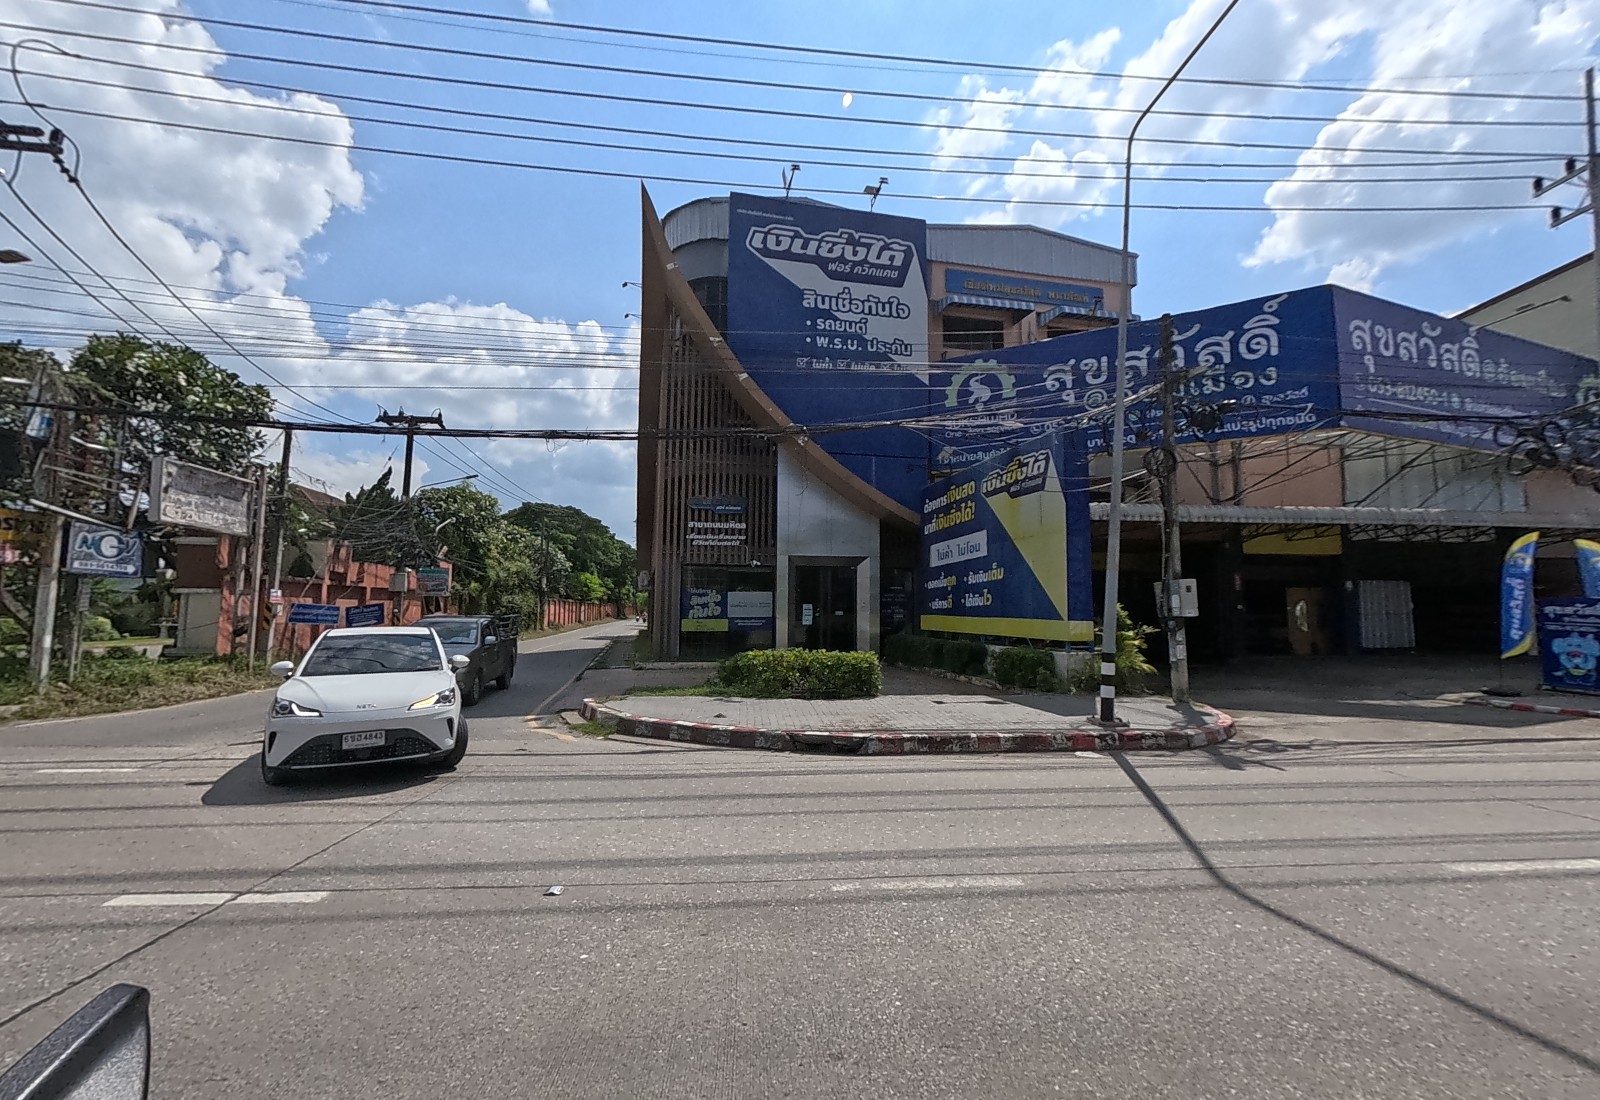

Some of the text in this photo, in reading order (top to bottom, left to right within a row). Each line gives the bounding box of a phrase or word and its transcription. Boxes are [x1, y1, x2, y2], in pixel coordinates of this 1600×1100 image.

[828, 261, 899, 278] ฟอร์ ควิกแคช
[802, 288, 911, 319] สินเชื่อทันใจ
[816, 318, 867, 334] รถยนต์
[816, 335, 913, 356] พ.ร.บ. ประกัน
[1350, 319, 1482, 378] สุขสวัสดิ์
[687, 520, 747, 530] สาขาถนนมหิดล
[957, 541, 981, 557] ไม่โอน
[363, 731, 384, 741] 4843
